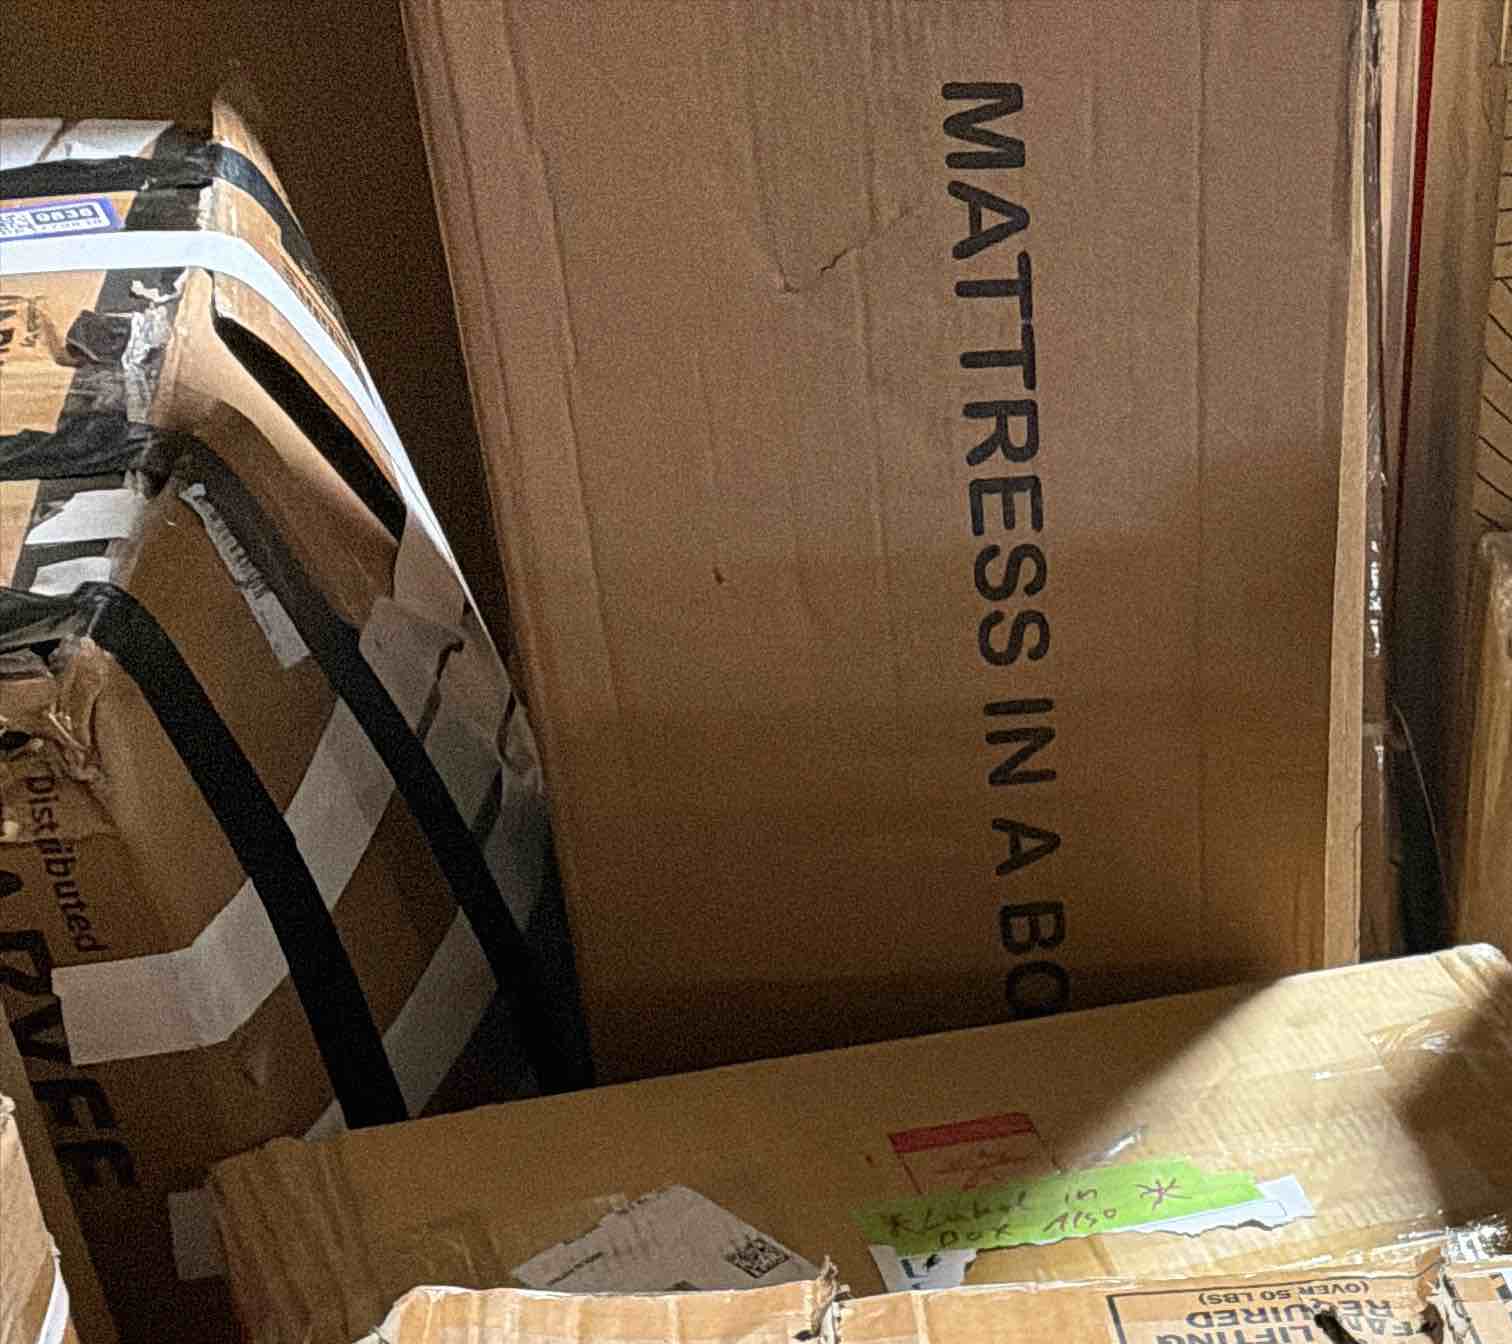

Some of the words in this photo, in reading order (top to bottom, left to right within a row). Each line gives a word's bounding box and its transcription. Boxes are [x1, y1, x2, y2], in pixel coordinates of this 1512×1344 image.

[941, 80, 1050, 668] MATTRESS
[984, 697, 1057, 788] IN
[24, 774, 110, 953] Distributed
[991, 817, 1061, 876] A
[1000, 900, 1072, 1018] BO
[1199, 1289, 1255, 1305] LBS)
[1260, 1288, 1291, 1302] 50
[1300, 1281, 1370, 1296] (OVER
